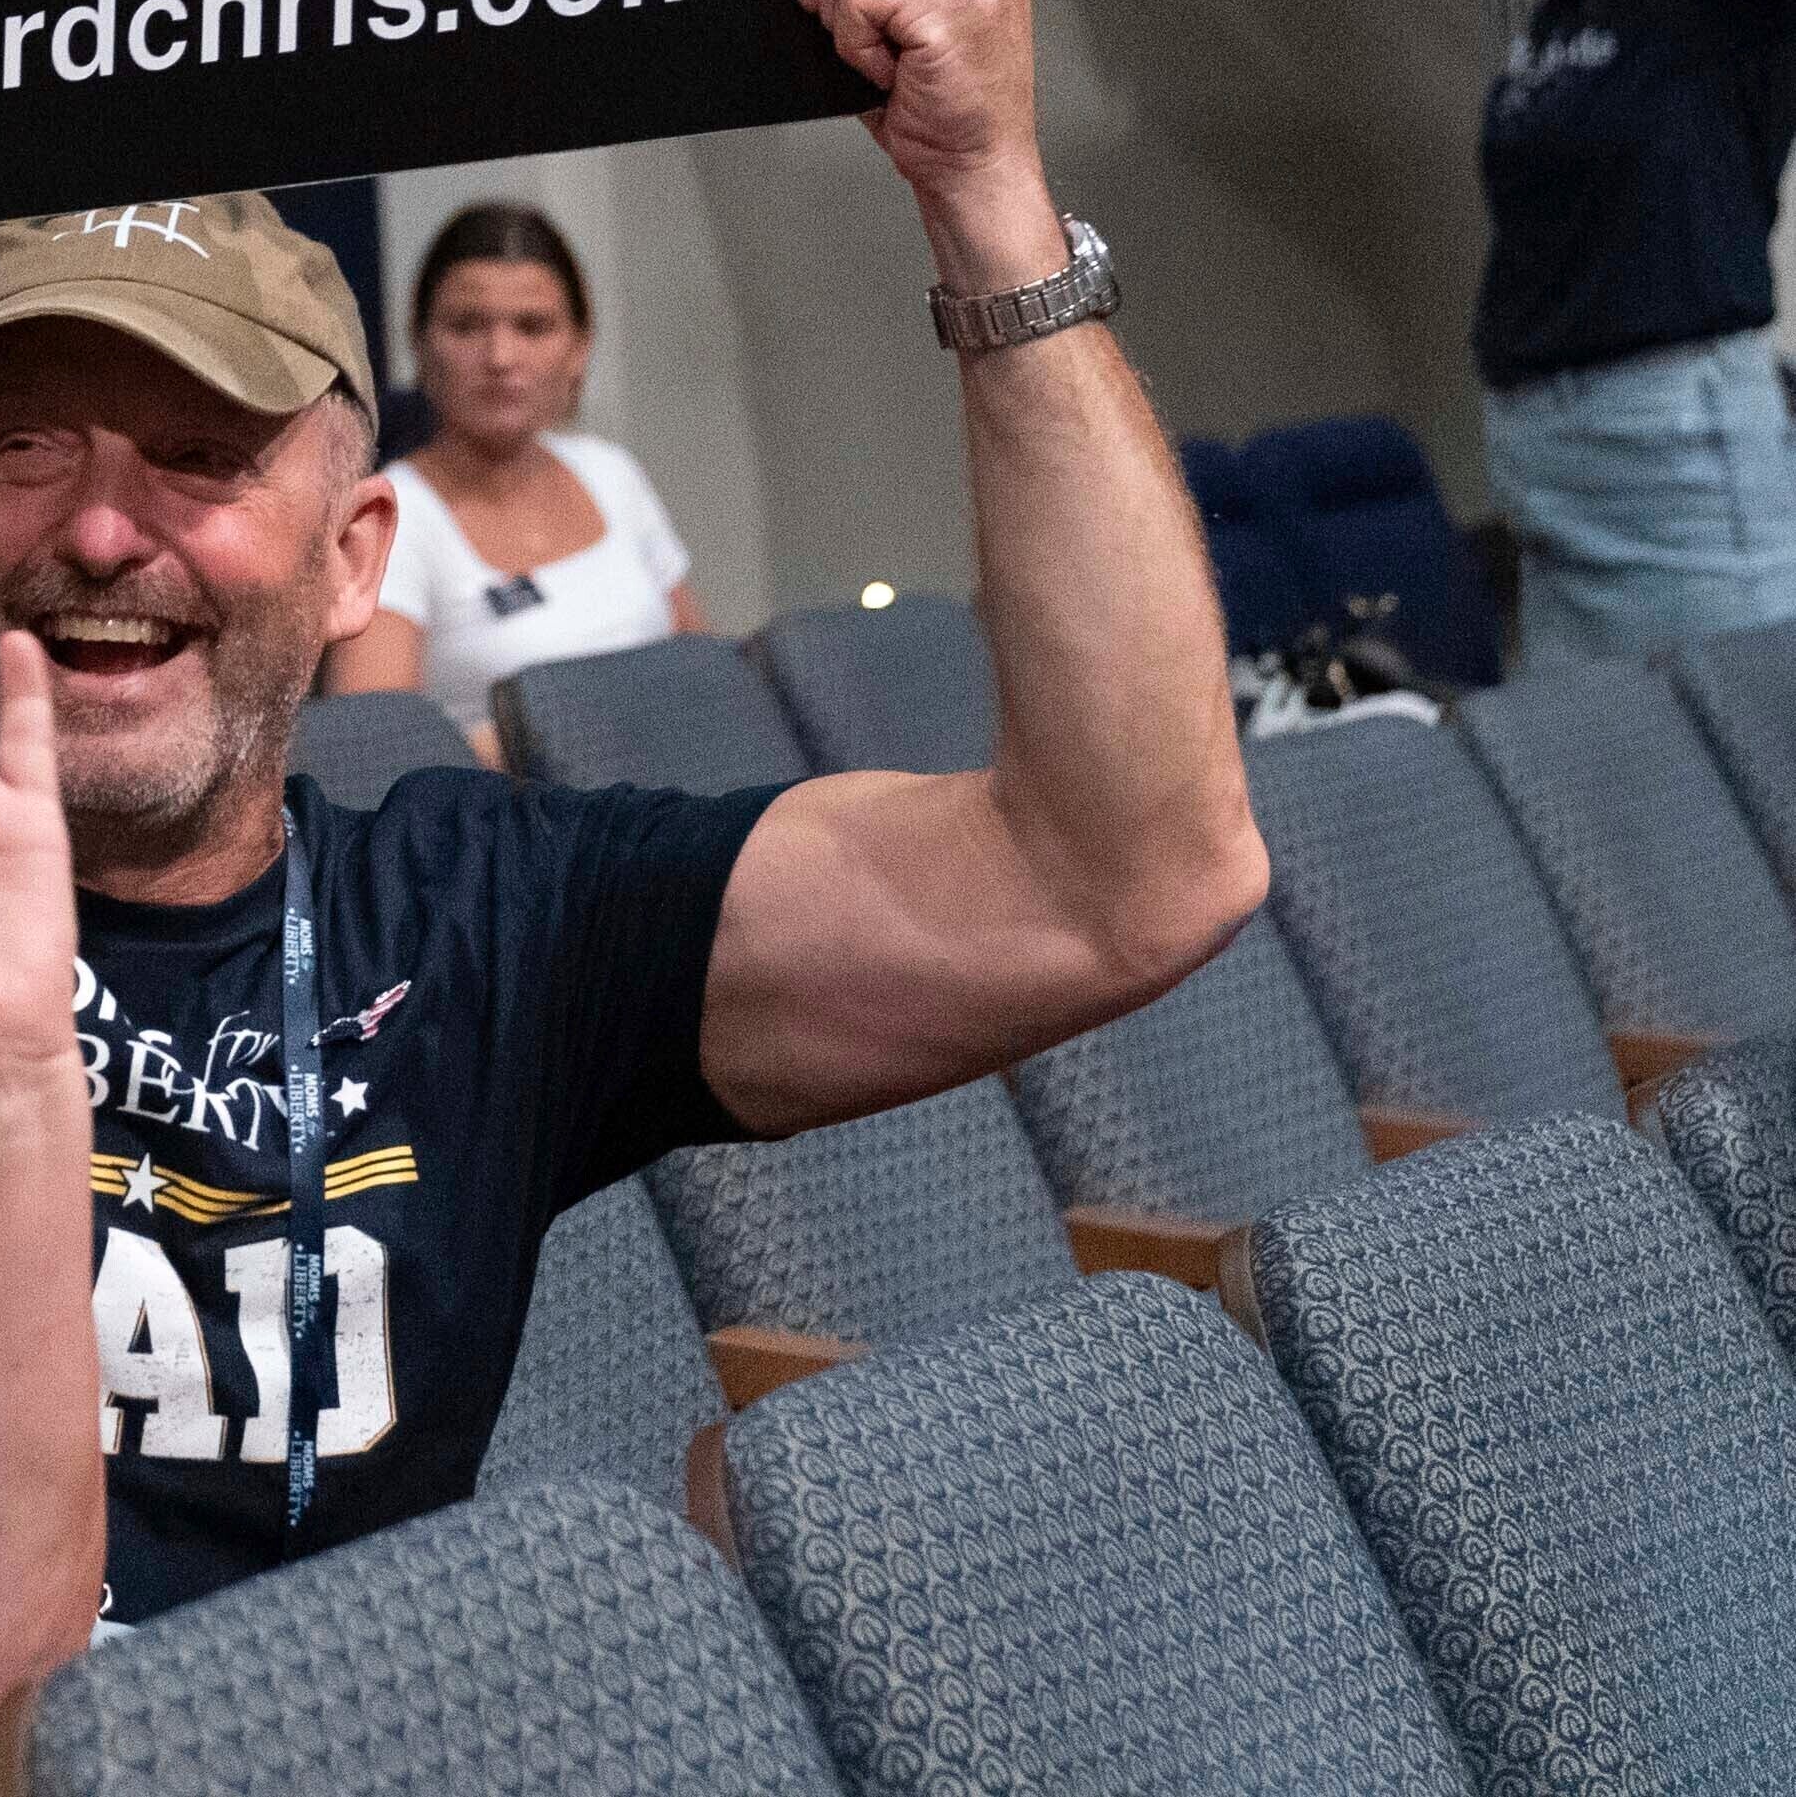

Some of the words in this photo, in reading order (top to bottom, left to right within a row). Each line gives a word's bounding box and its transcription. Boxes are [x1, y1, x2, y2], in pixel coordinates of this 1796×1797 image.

[285, 914, 299, 978] LIBERTY
[288, 1073, 307, 1146] LIBERTY
[304, 1073, 320, 1118] MOMS
[293, 1253, 308, 1332] LIBERTY
[308, 1254, 322, 1303] MOMS
